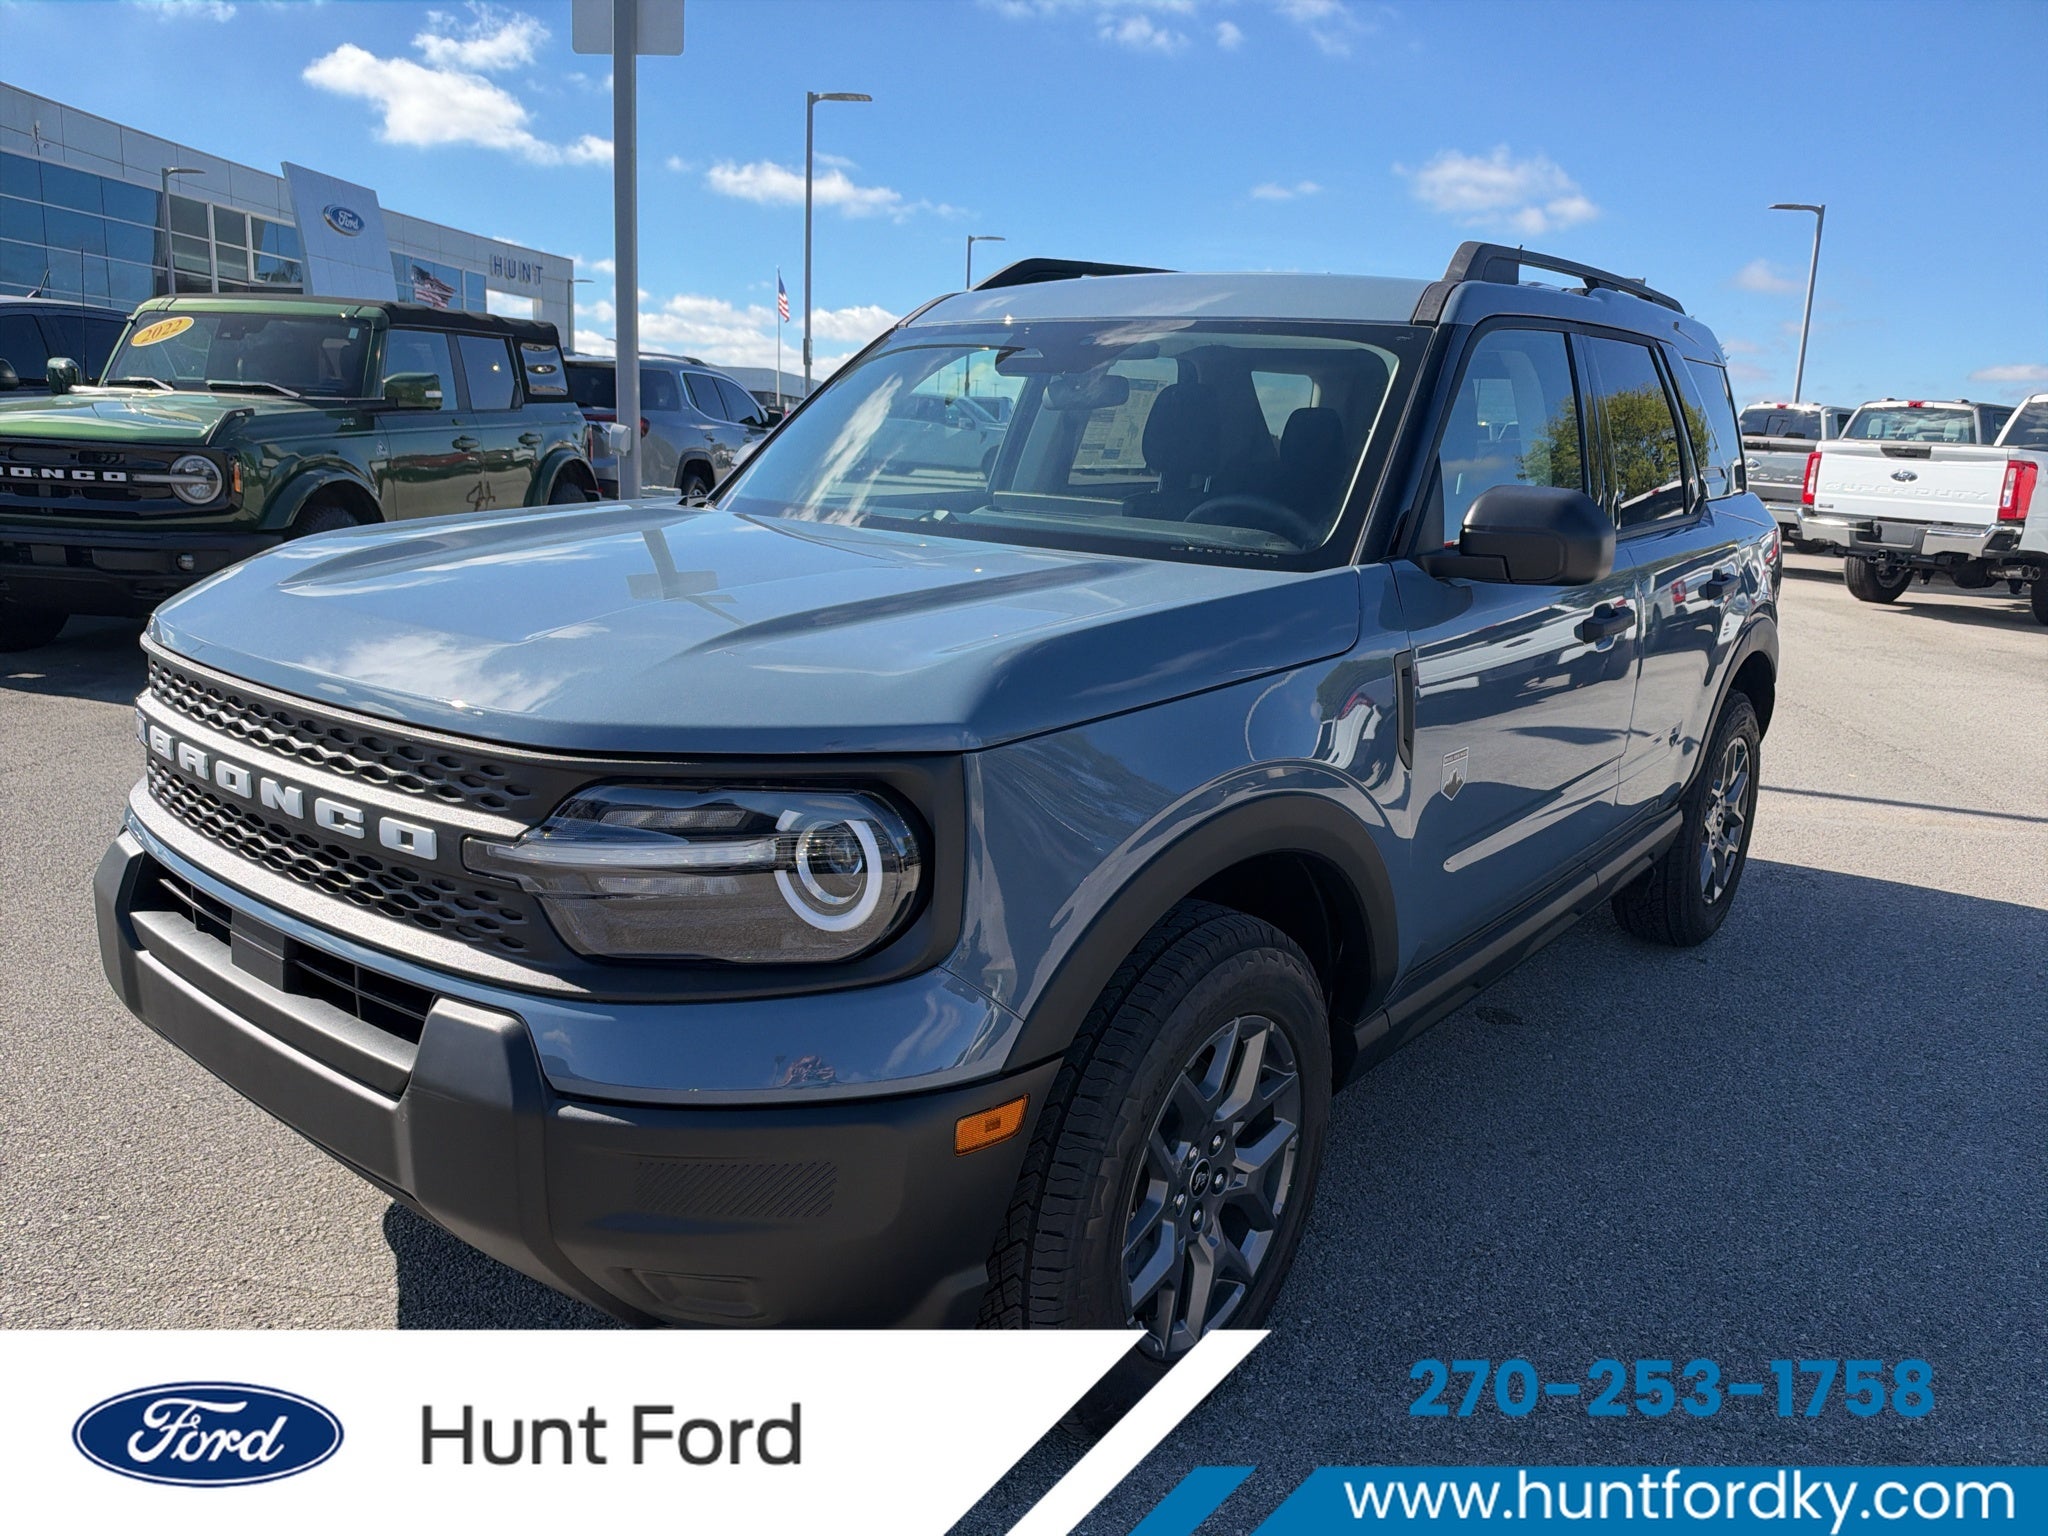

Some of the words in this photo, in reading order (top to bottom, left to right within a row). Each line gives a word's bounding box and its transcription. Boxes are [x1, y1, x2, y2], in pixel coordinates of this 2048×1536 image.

[338, 210, 360, 230] Ford
[493, 255, 544, 285] HUNT
[140, 319, 183, 344] 2022
[0, 465, 127, 482] ONCO
[1824, 481, 1906, 497] SUPER
[1914, 486, 1990, 500] DUTY
[149, 724, 438, 861] BRONCO
